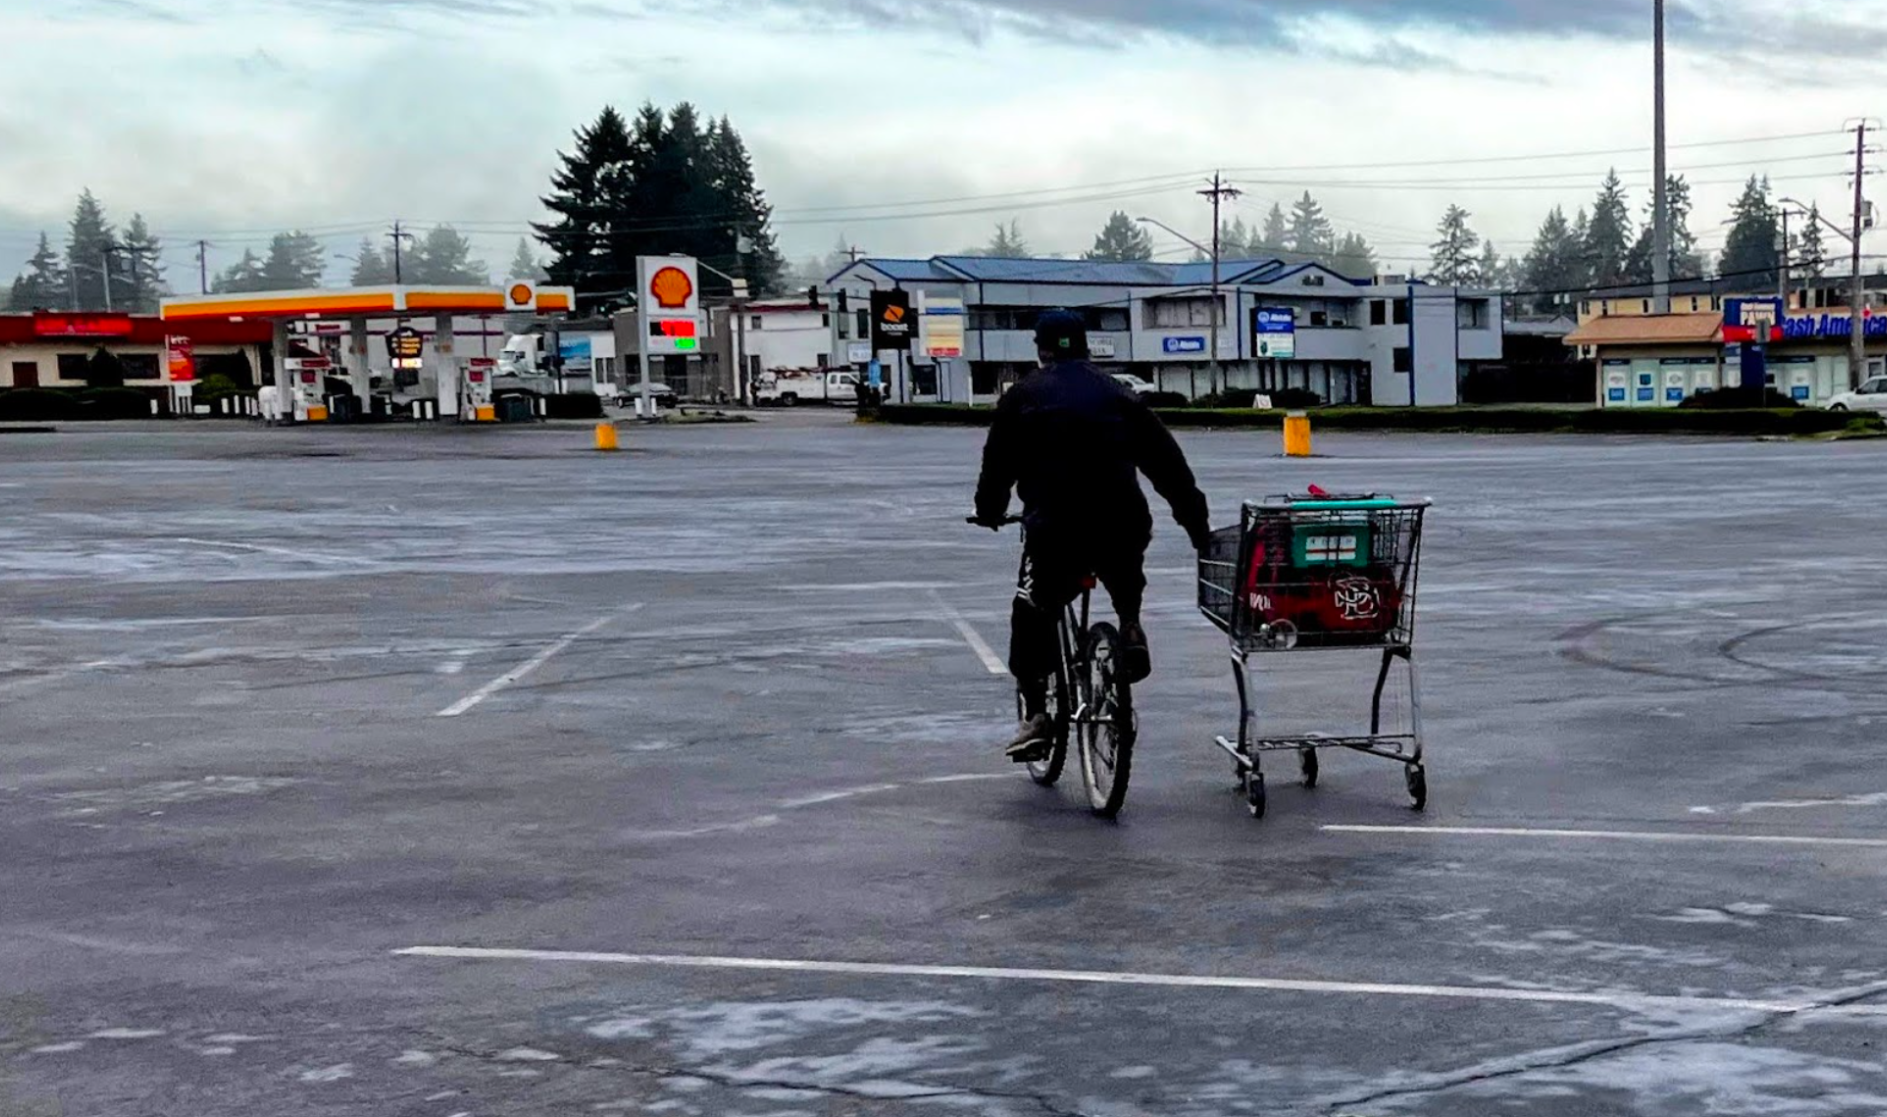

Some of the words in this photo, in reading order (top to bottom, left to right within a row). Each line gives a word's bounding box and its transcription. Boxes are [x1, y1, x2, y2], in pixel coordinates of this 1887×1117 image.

[881, 323, 908, 331] boost
[1783, 315, 1814, 336] ash
[1817, 311, 1887, 336] Ameica
